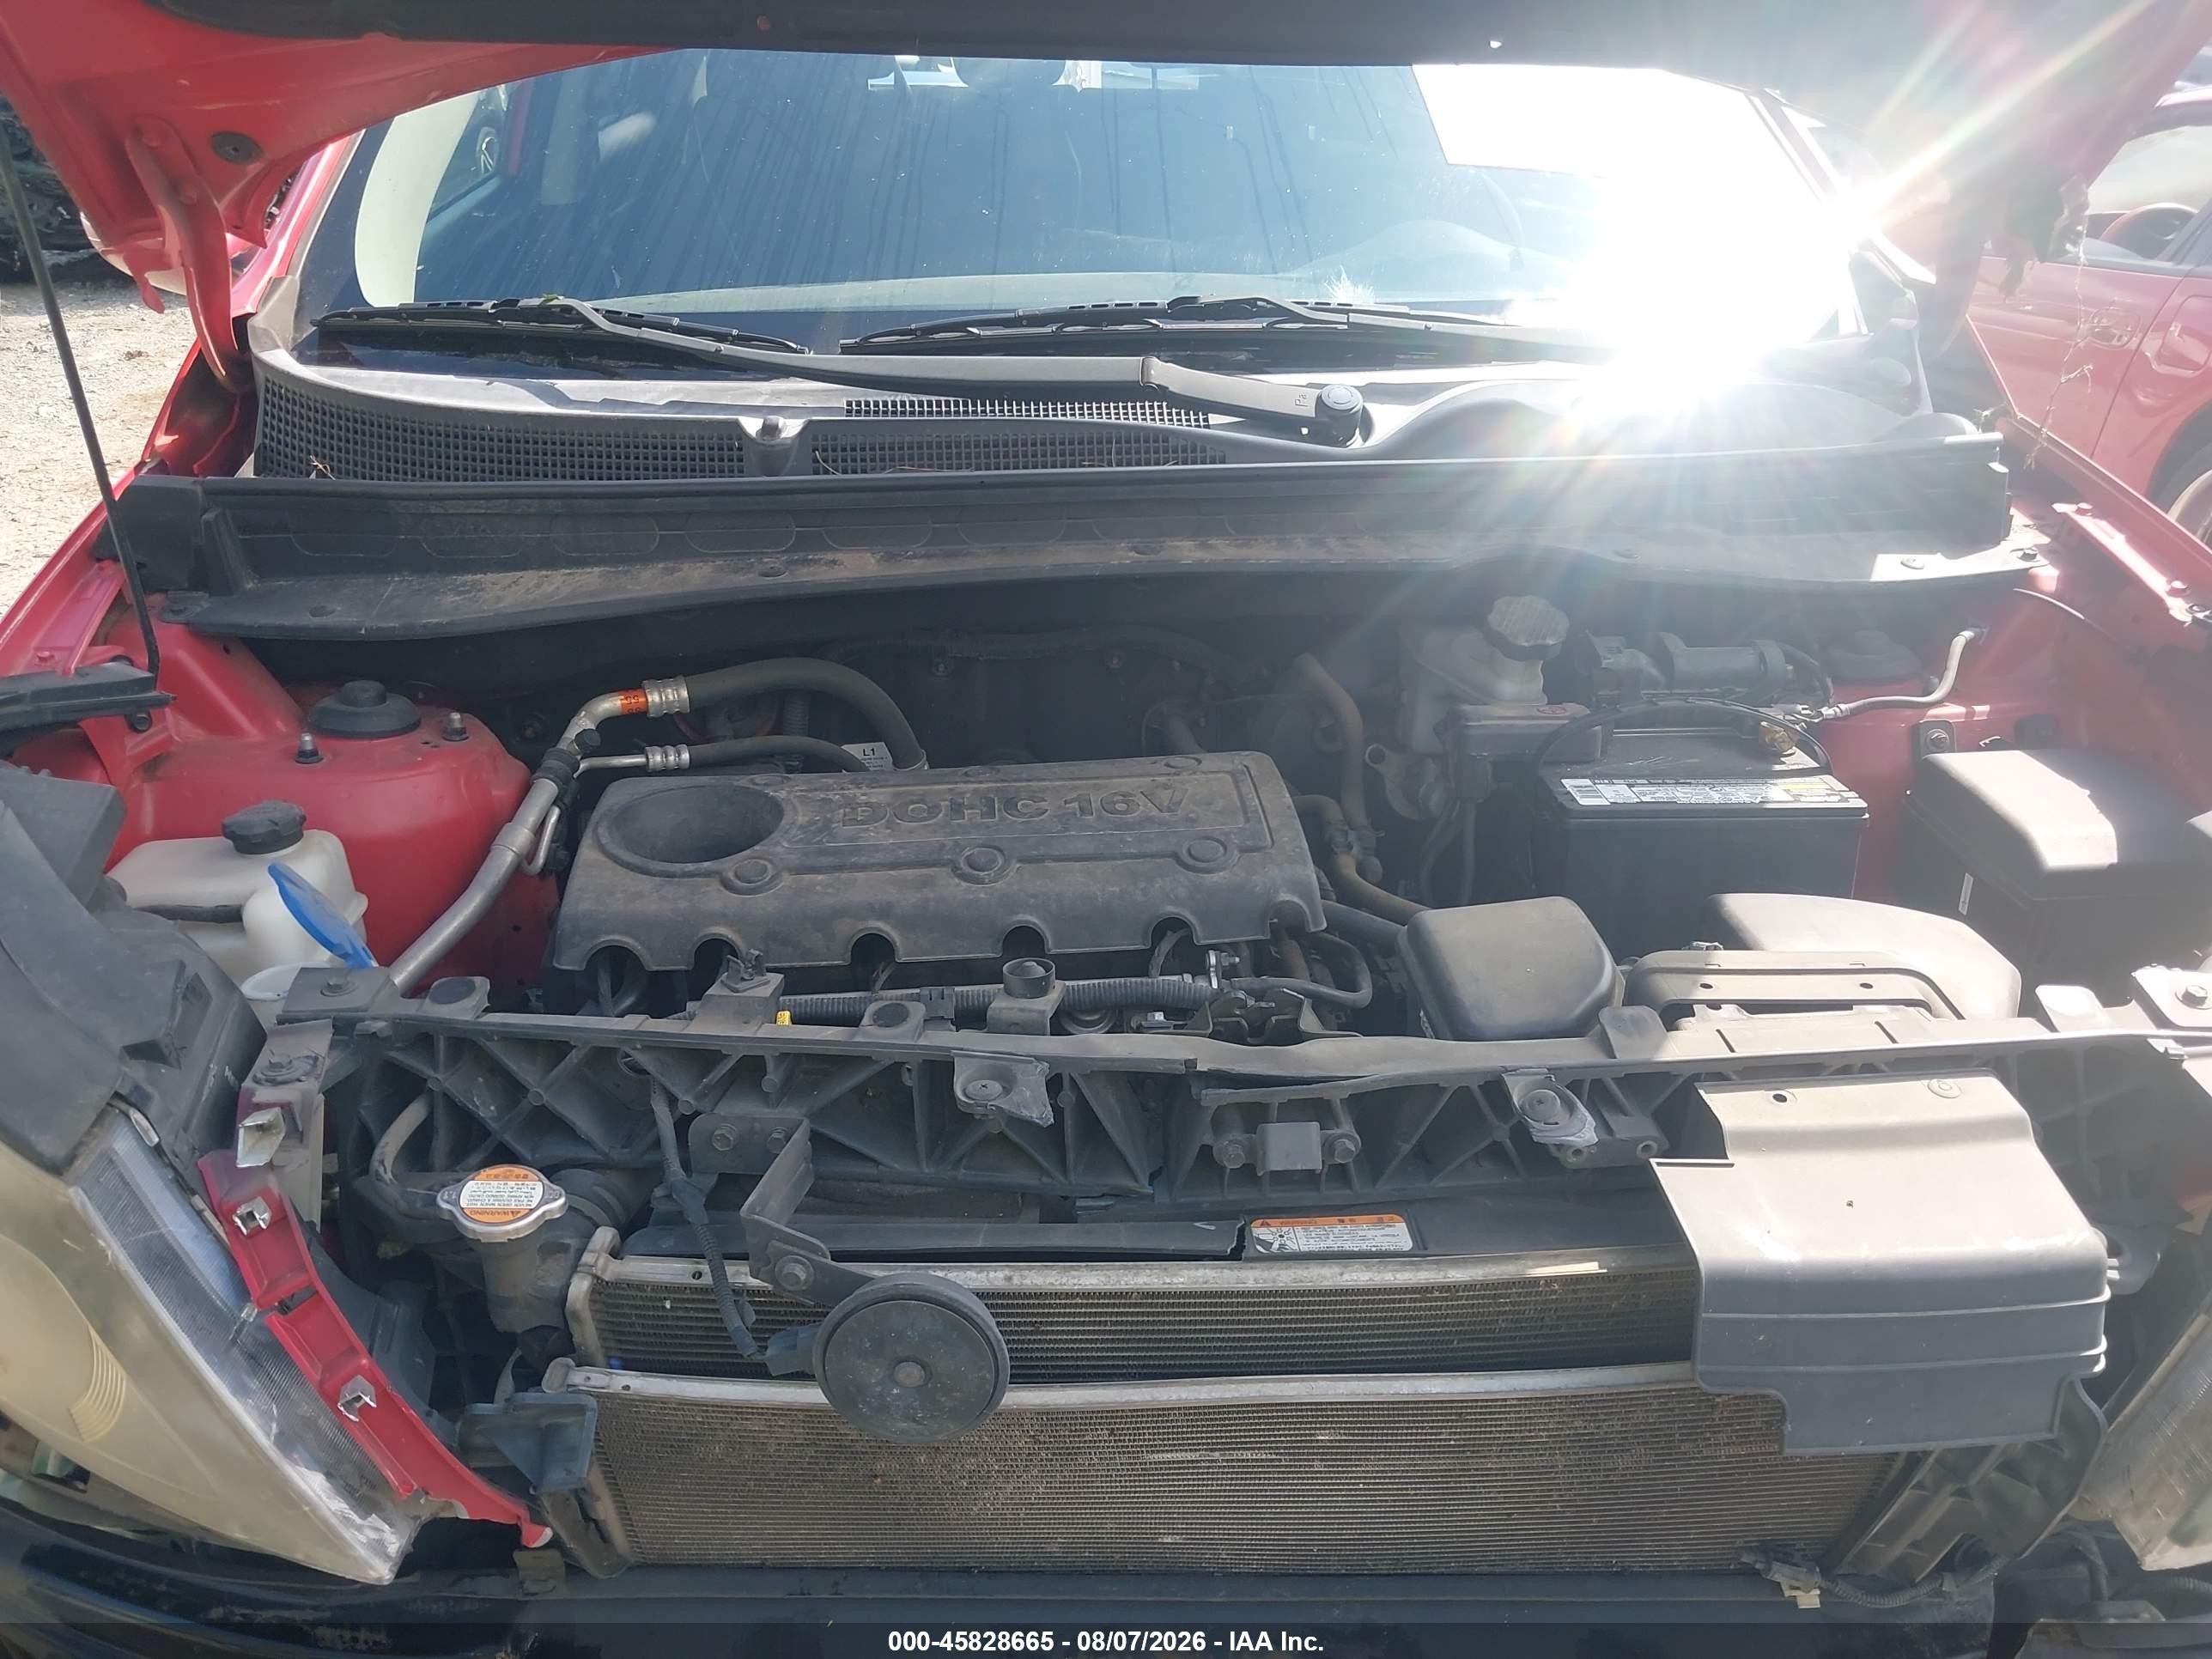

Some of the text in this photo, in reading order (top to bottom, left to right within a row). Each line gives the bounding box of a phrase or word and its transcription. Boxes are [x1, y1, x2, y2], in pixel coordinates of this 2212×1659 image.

[862, 747, 875, 757] L1
[841, 788, 1190, 829] DOHC 16V
